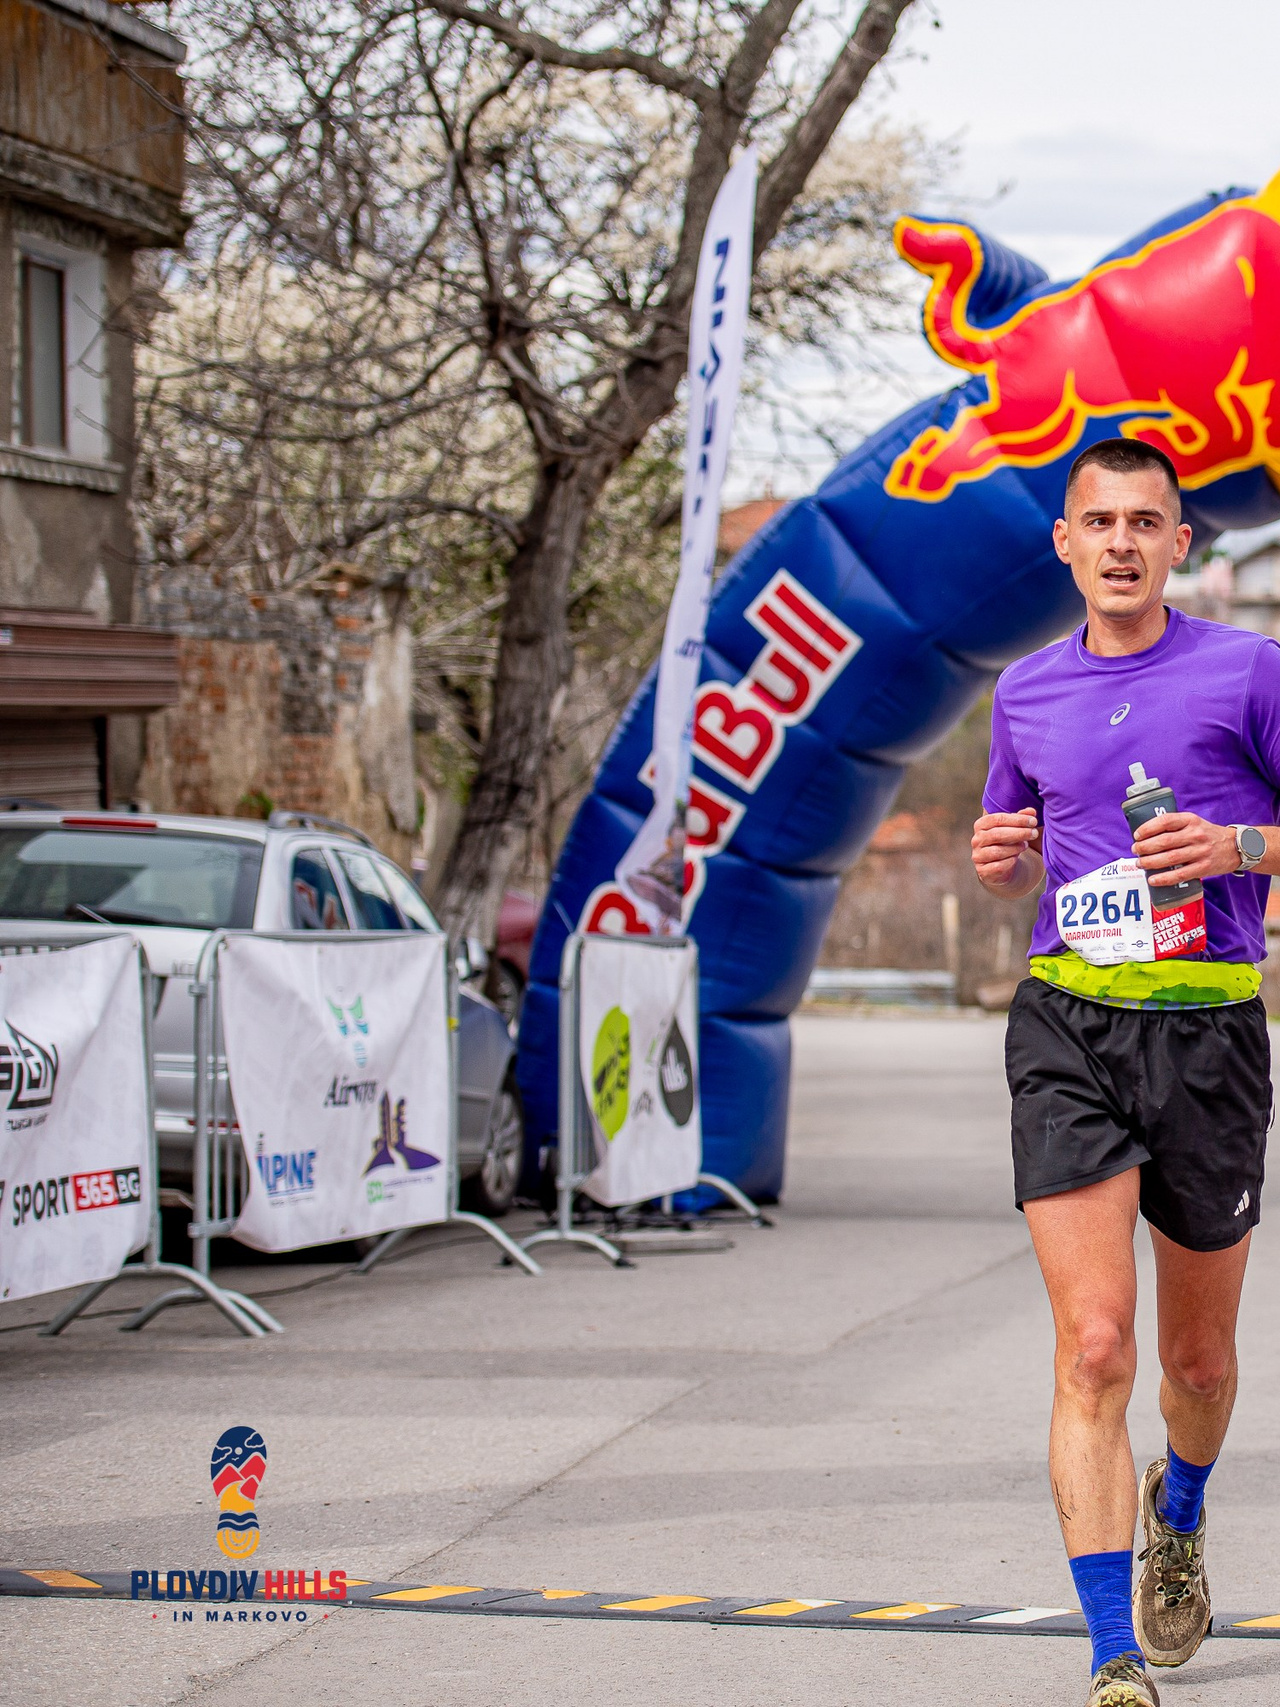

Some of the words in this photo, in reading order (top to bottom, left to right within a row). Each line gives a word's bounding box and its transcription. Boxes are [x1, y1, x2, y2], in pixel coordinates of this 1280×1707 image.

[691, 574, 857, 790] Bull
[1101, 864, 1119, 876] 22K
[1061, 889, 1144, 928] 2264
[1152, 911, 1185, 932] EVERY
[1065, 929, 1101, 942] MARKOVO
[1102, 928, 1123, 938] TRAIL
[1153, 927, 1182, 944] STEP
[1157, 925, 1206, 953] MATTERS
